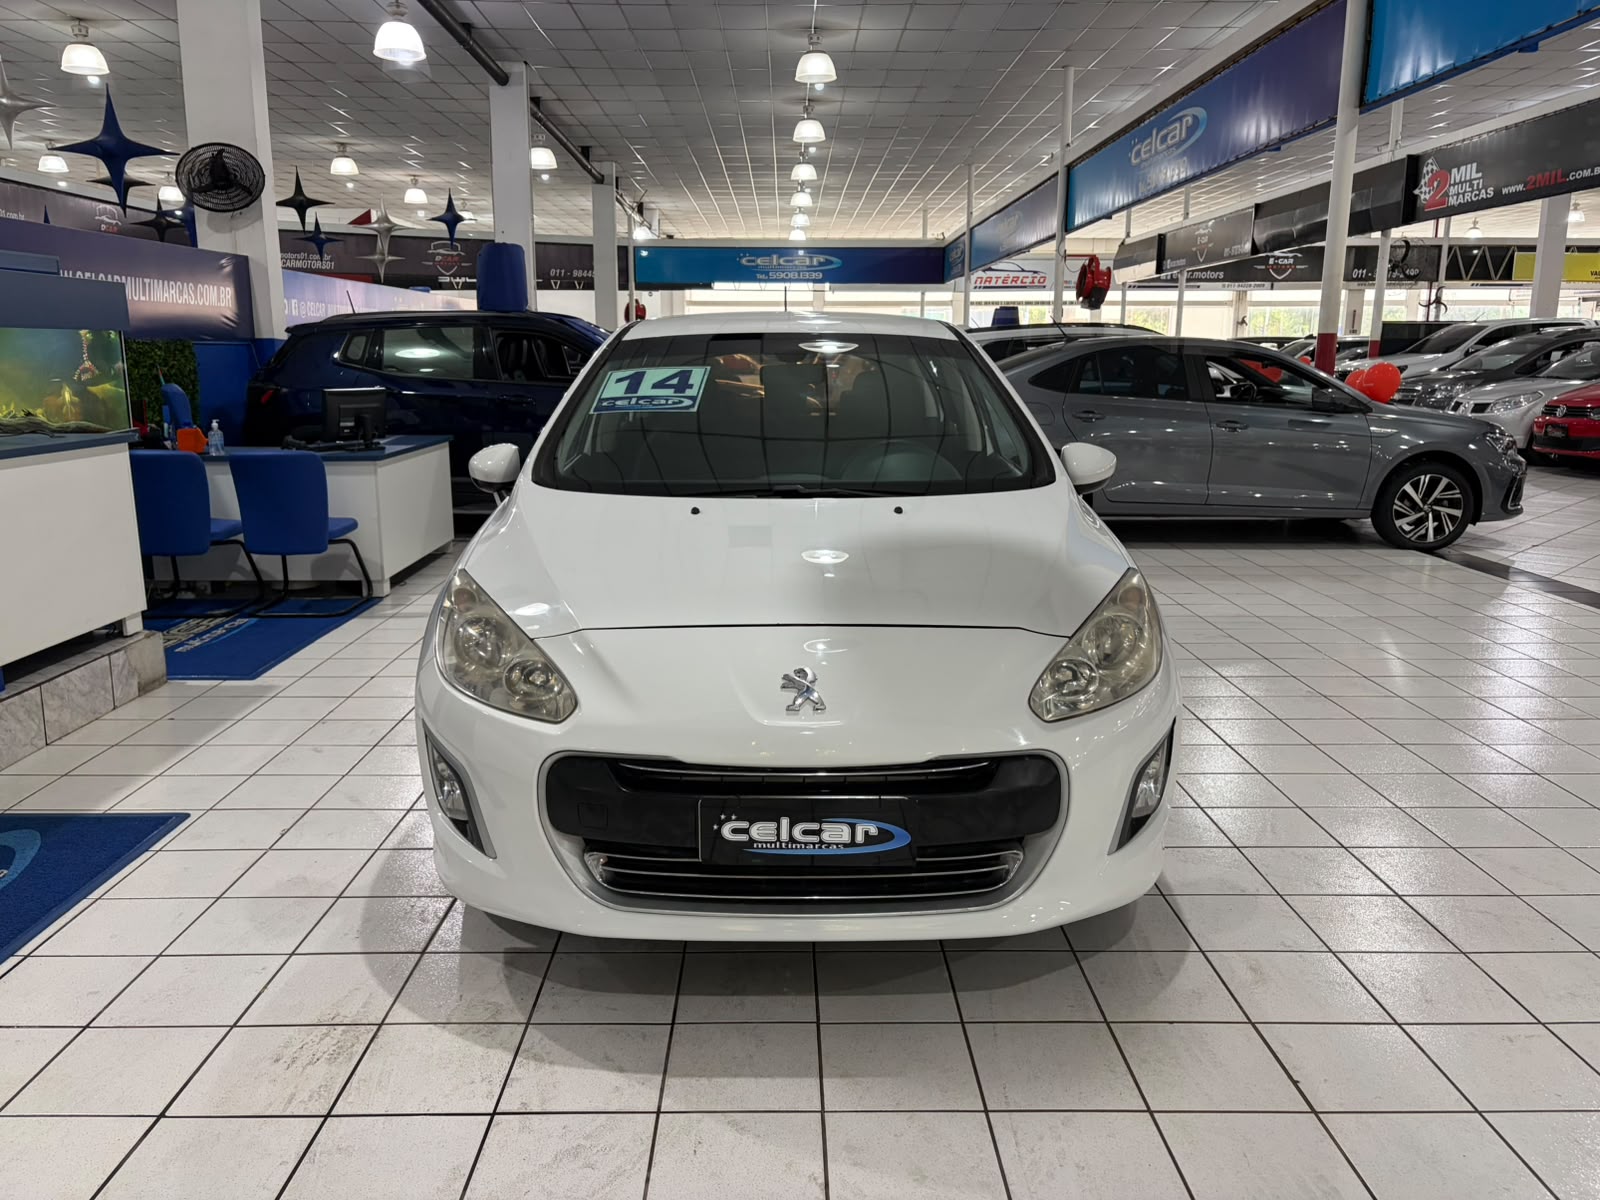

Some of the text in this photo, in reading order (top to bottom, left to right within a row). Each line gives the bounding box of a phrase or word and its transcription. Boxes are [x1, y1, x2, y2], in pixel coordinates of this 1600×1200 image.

[1131, 115, 1194, 167] celcar
[1424, 162, 1483, 212] 2 MIL
[1449, 178, 1483, 196] MULTI
[1448, 186, 1495, 208] MARCAS
[741, 254, 826, 267] celcar
[549, 268, 565, 277] 011
[1352, 268, 1367, 279] 011
[614, 369, 695, 395] 14
[601, 397, 681, 407] celcar
[720, 816, 879, 844] celcar
[753, 841, 845, 850] multimarcas
